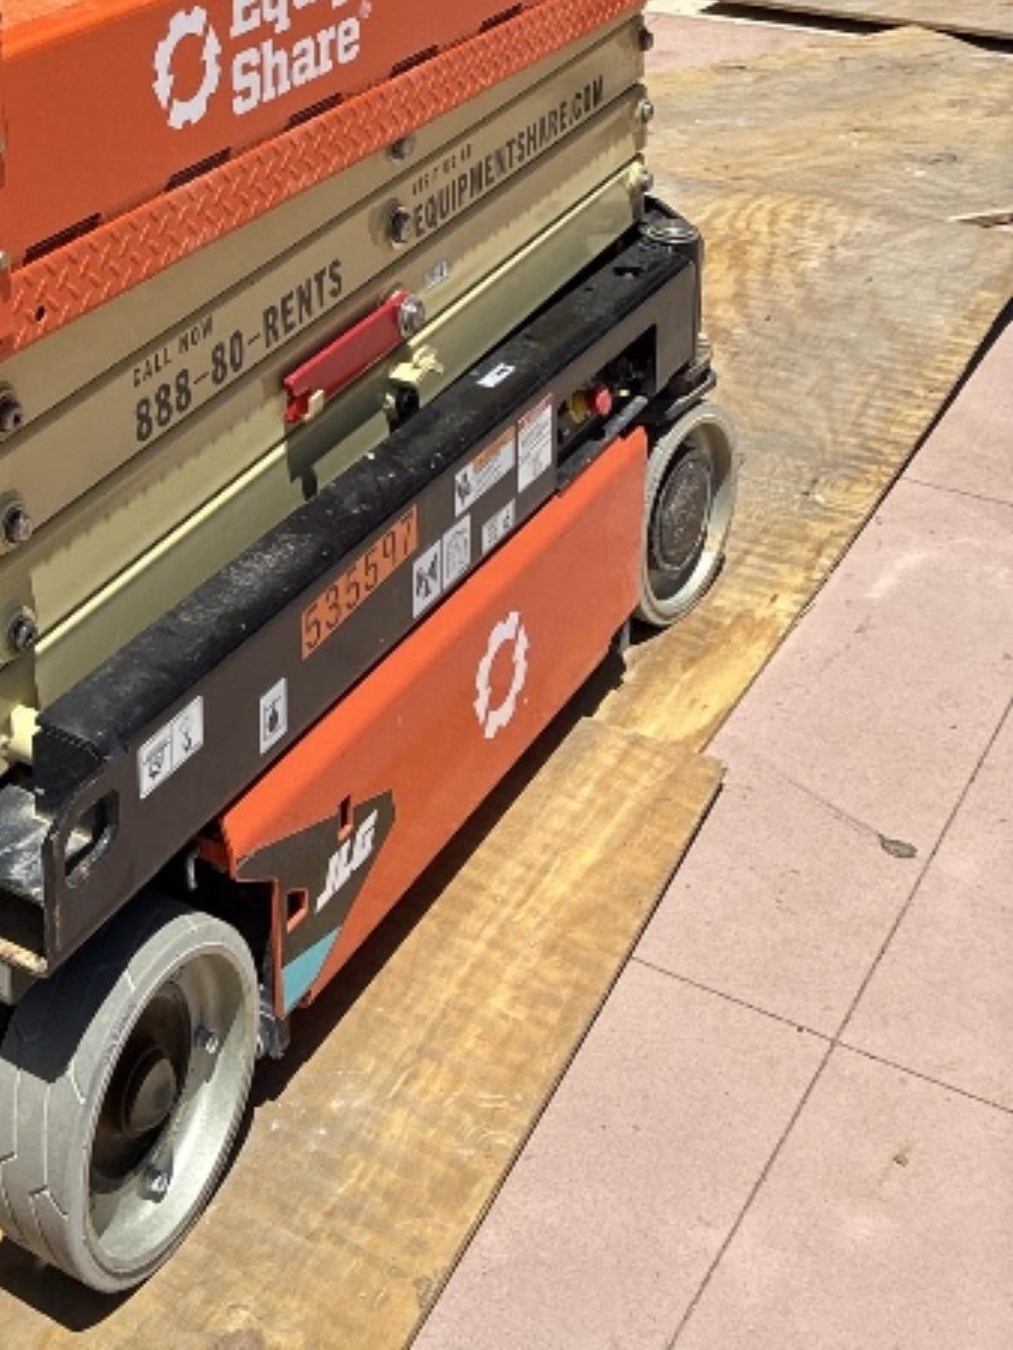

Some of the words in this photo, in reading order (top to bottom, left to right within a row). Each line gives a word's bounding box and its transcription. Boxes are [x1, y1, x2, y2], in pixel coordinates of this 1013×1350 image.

[231, 16, 361, 116] Share
[414, 74, 604, 238] EQUIPMENTSHARE.COM
[133, 346, 172, 388] CALL
[178, 314, 214, 356] NOW
[135, 257, 343, 442] 888-80-RENTS
[304, 511, 413, 649] 535597
[315, 809, 378, 913] JLG
